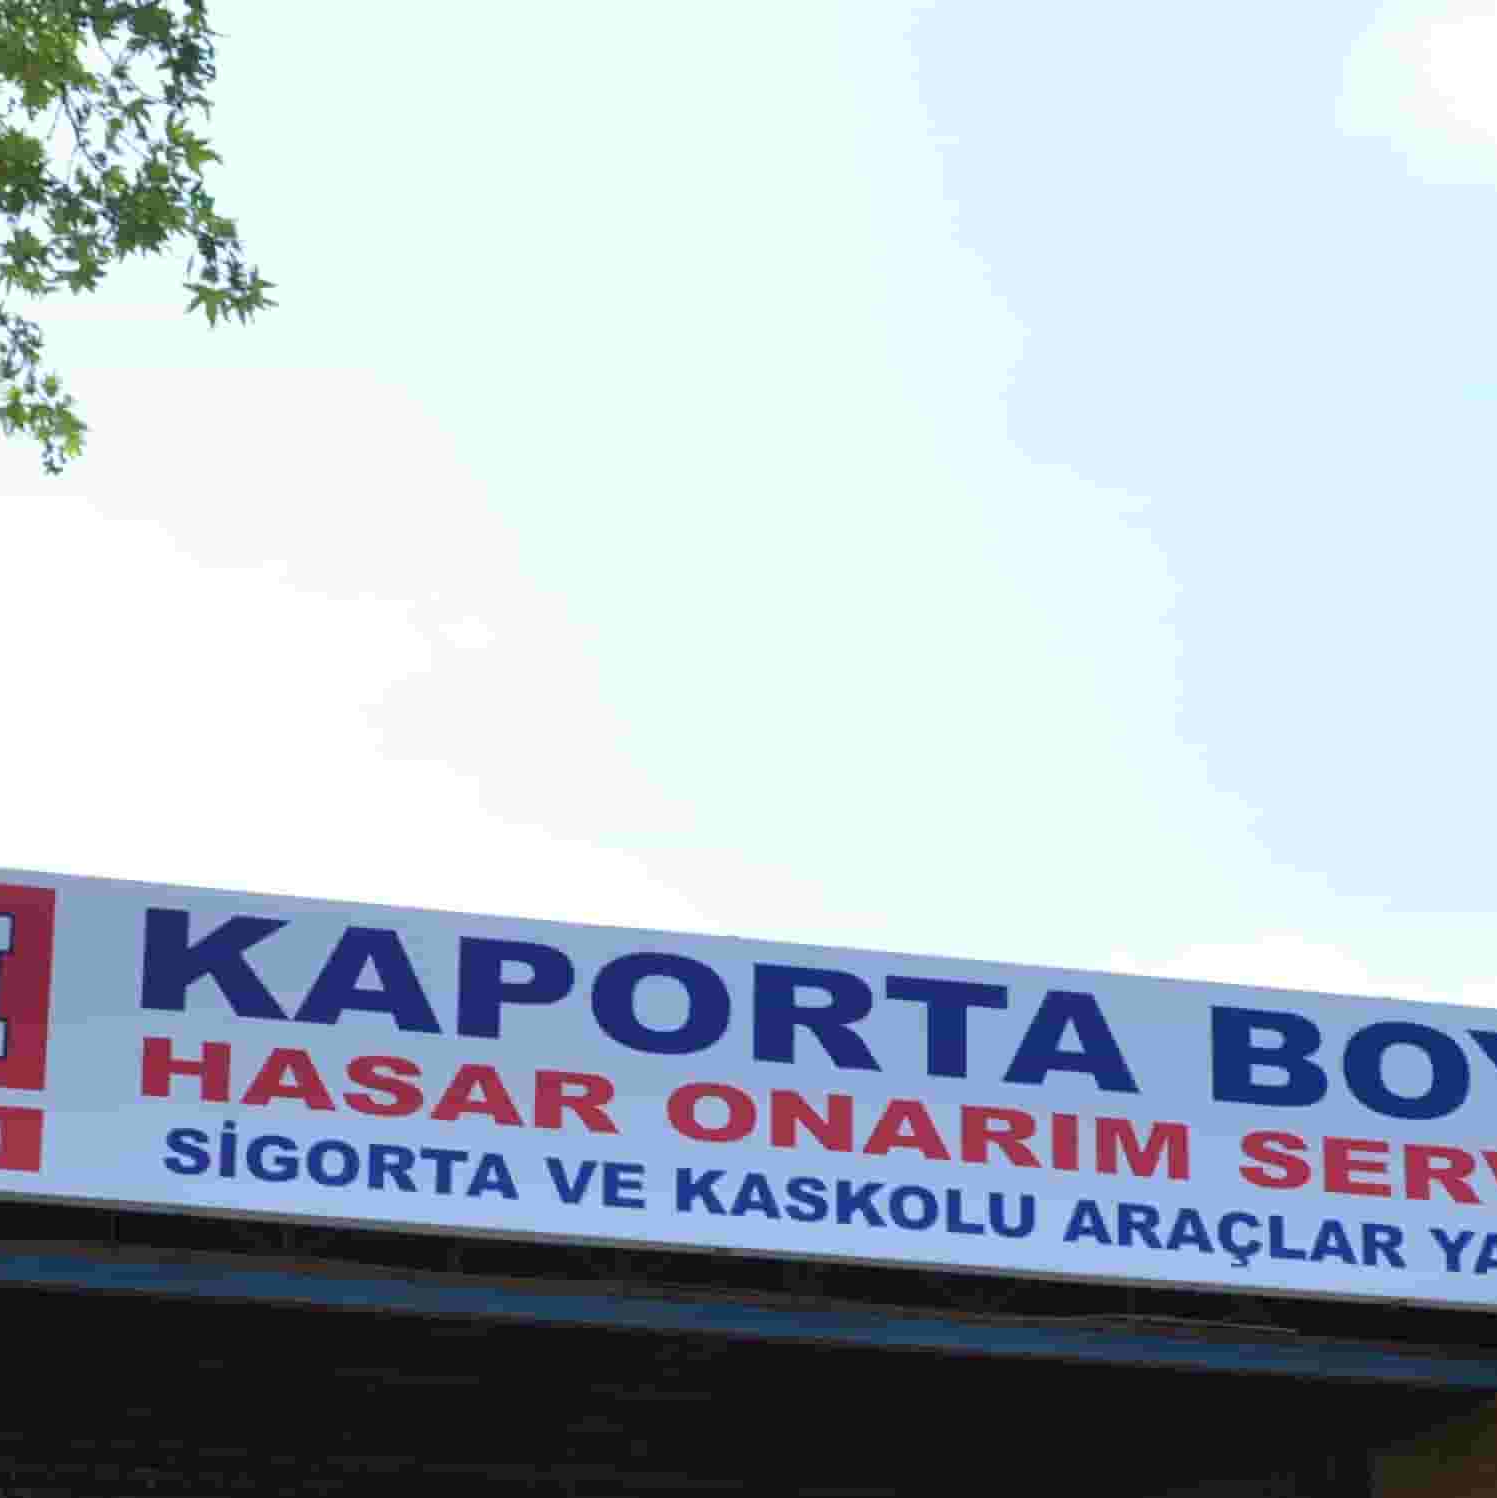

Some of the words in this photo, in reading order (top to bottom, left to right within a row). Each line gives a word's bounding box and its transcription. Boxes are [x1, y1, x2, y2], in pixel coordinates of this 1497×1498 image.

[140, 906, 1141, 1095] KAPORTA
[140, 1036, 620, 1134] HASAR
[666, 1082, 1190, 1181] ONARIM
[163, 1120, 519, 1201] SİGORTA
[545, 1156, 645, 1209] VE
[676, 1167, 1035, 1239] KASKOLU
[1062, 1199, 1407, 1268] ARAÇLAR
